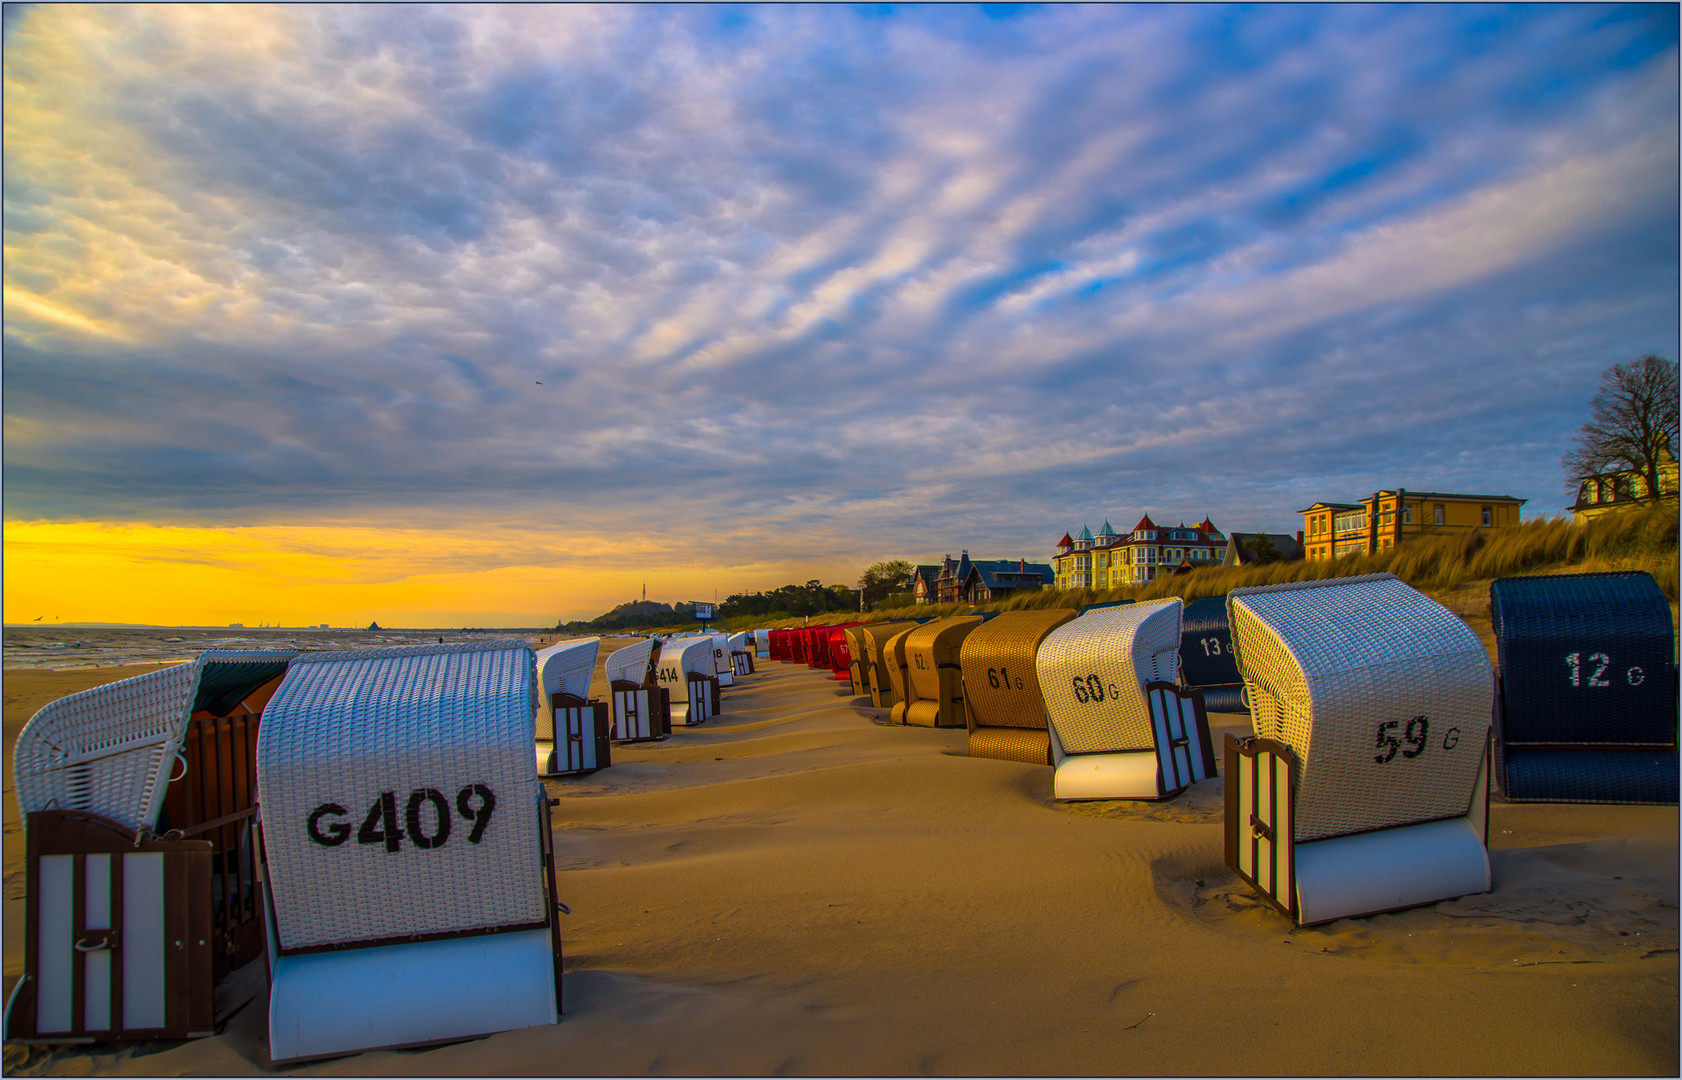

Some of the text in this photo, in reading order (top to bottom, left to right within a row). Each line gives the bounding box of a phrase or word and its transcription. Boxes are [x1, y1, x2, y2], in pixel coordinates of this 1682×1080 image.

[840, 644, 848, 654] 67
[1201, 637, 1221, 656] 13
[914, 653, 926, 670] 62
[1565, 652, 1645, 687] 12 G
[987, 667, 1024, 690] 61 G
[1072, 673, 1119, 703] 60 G
[1375, 715, 1460, 764] 59 G
[306, 783, 496, 853] G409
